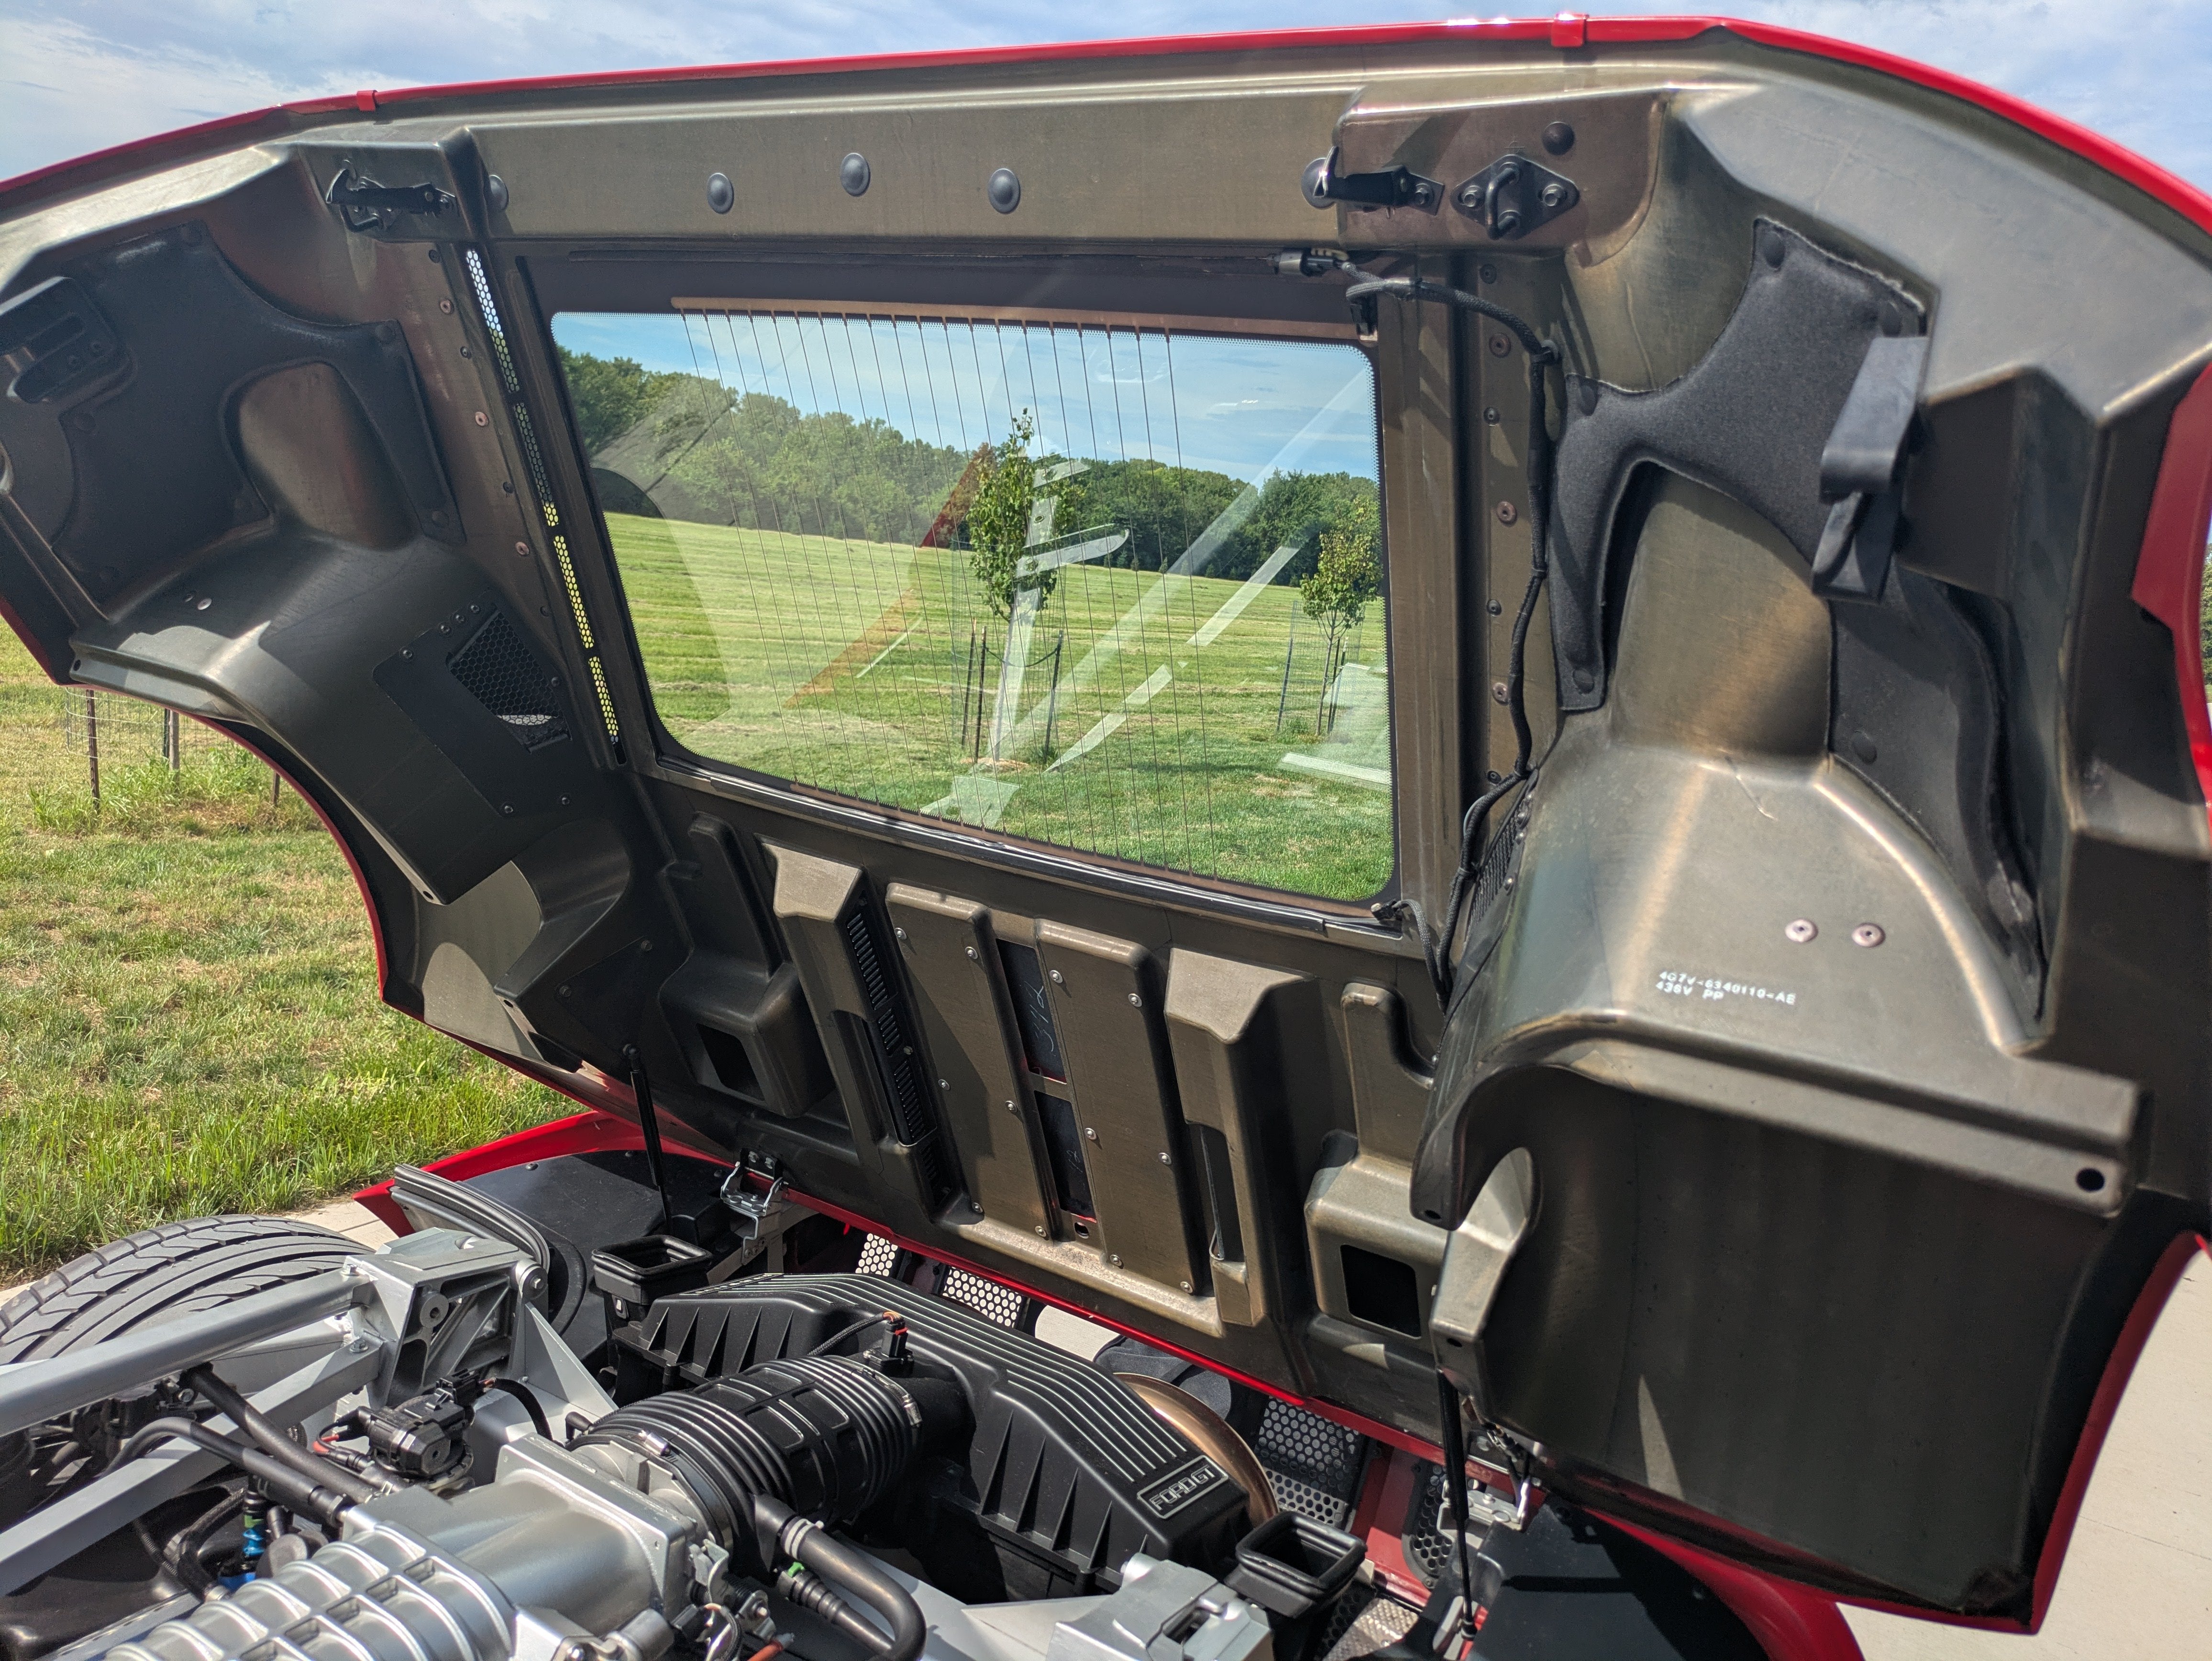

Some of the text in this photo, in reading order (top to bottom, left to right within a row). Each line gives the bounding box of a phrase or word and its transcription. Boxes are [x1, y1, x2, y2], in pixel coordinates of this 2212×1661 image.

[1703, 989, 1724, 1000] PP
[1149, 1464, 1216, 1511] FORD GT
